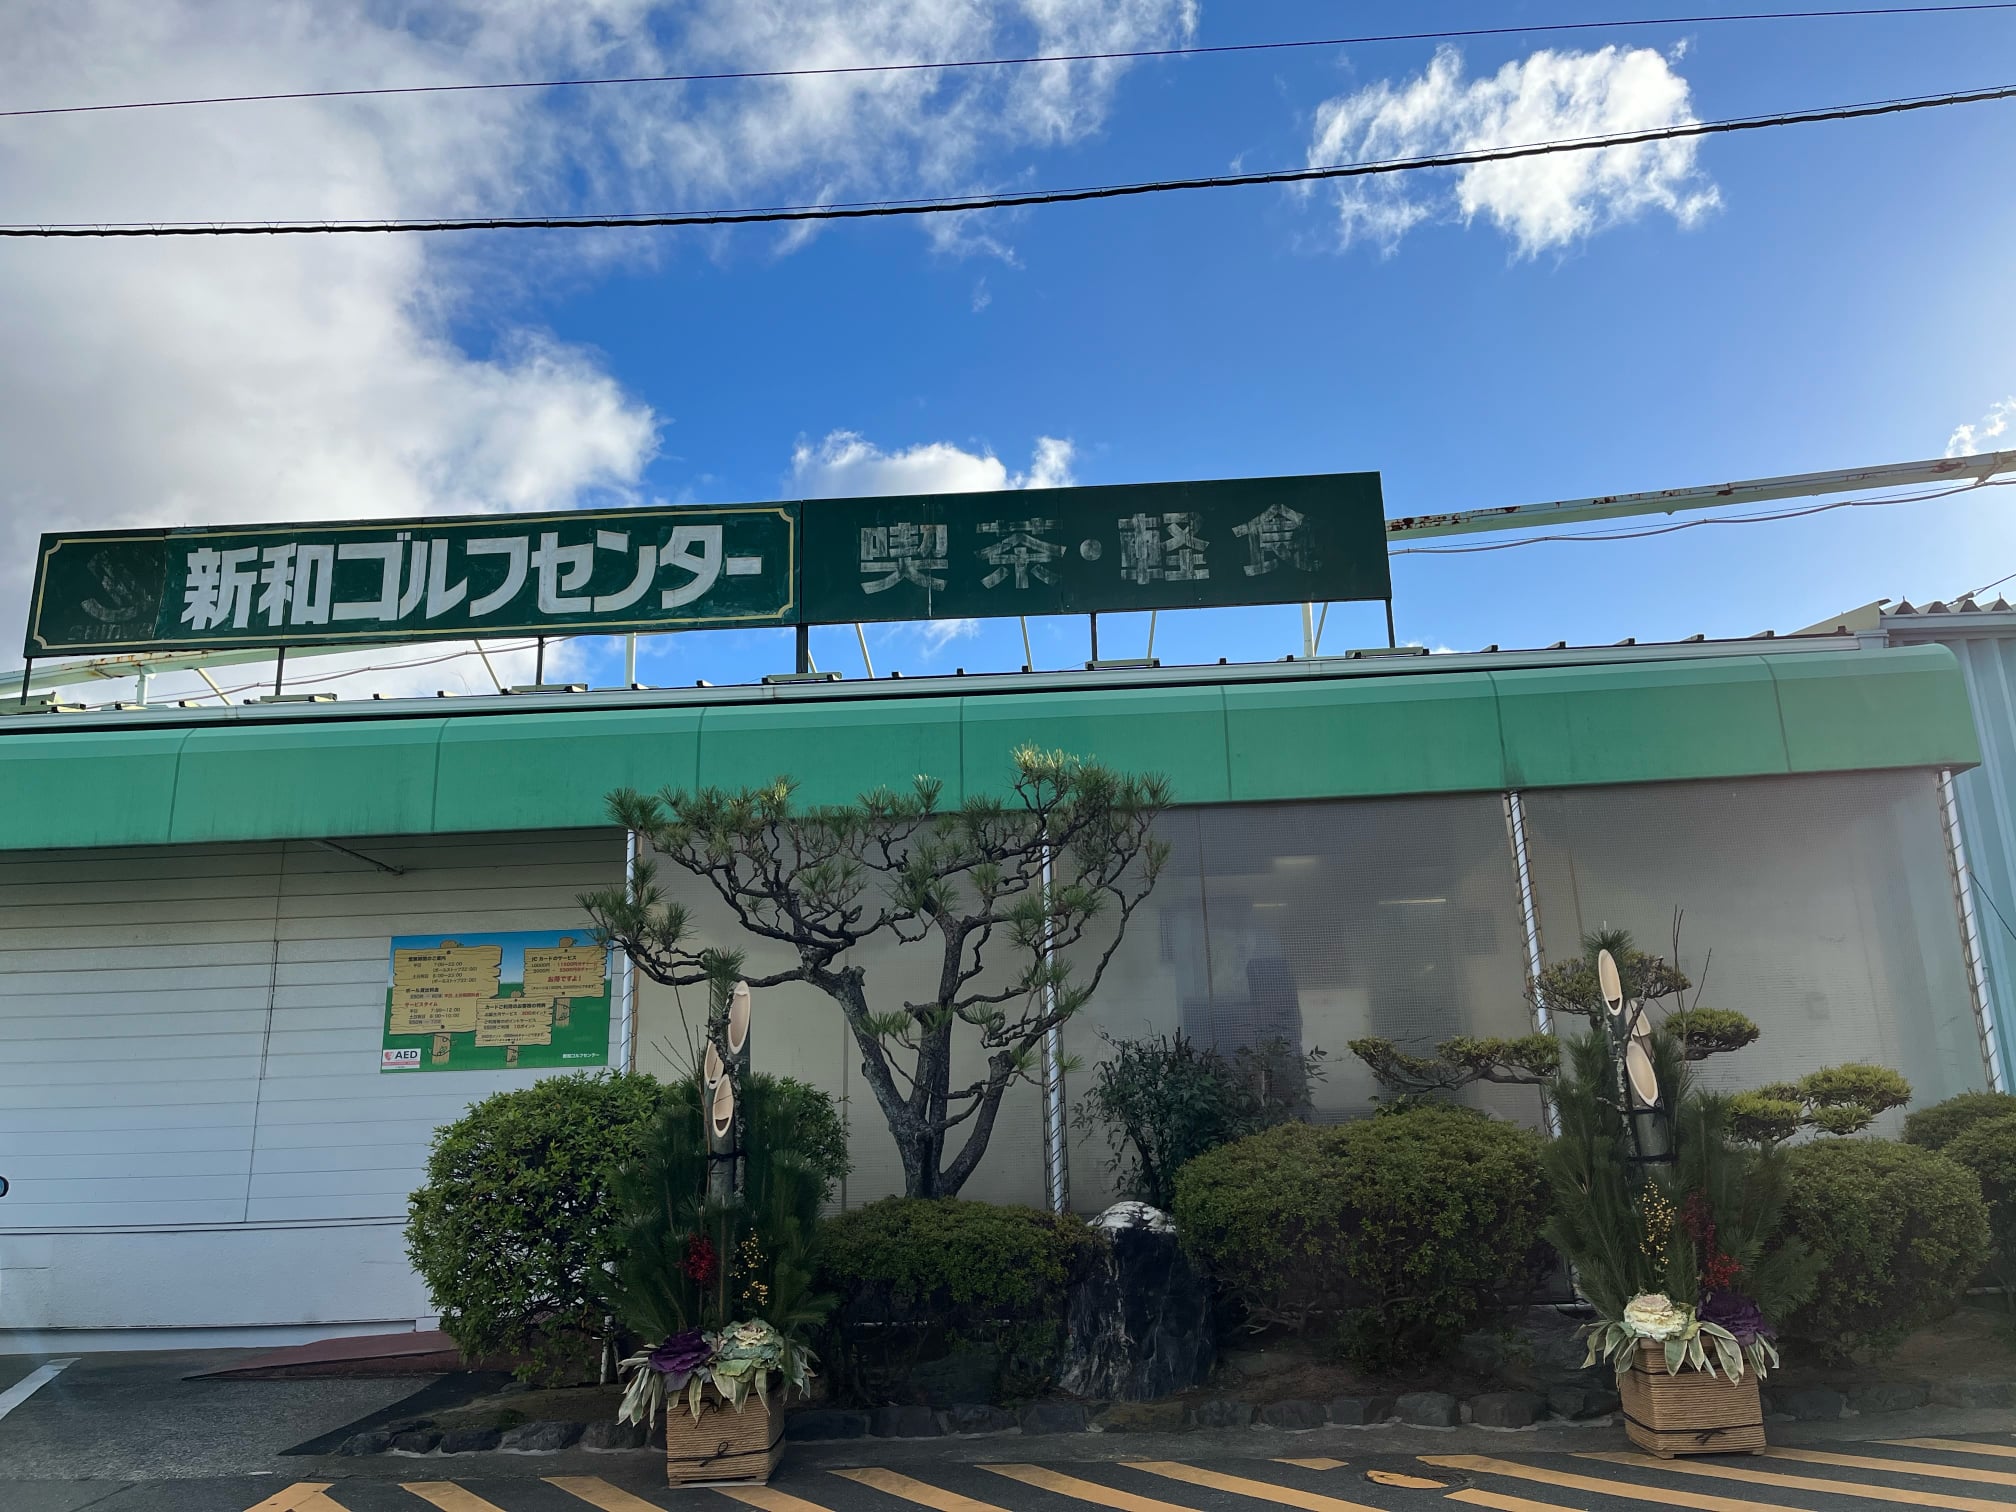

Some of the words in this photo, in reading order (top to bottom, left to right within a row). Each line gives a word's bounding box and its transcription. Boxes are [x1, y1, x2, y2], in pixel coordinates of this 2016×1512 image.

[180, 524, 763, 631] 新和ゴルフセンター
[860, 502, 1322, 594] 喫茶・軽食
[395, 1050, 418, 1059] AED
